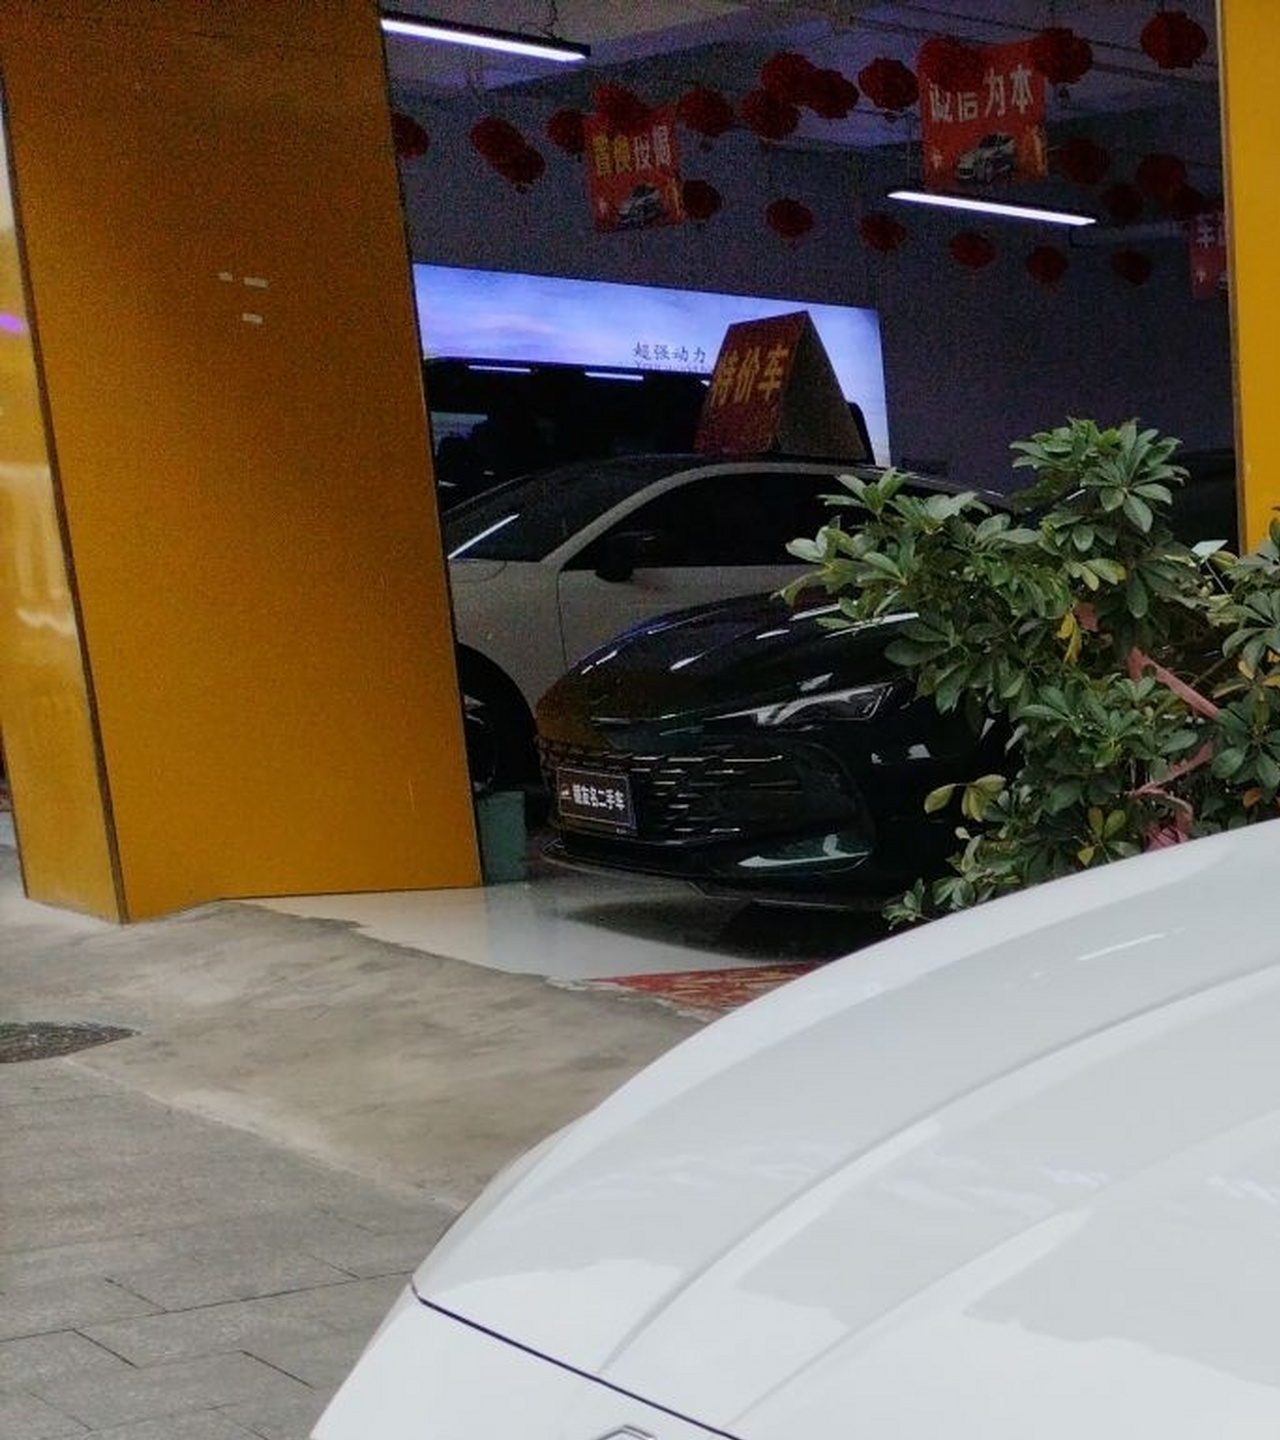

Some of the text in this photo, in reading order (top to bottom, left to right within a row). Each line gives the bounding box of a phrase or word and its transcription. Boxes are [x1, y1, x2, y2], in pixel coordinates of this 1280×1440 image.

[632, 341, 706, 364] 超强动力
[711, 343, 791, 408] 特价车
